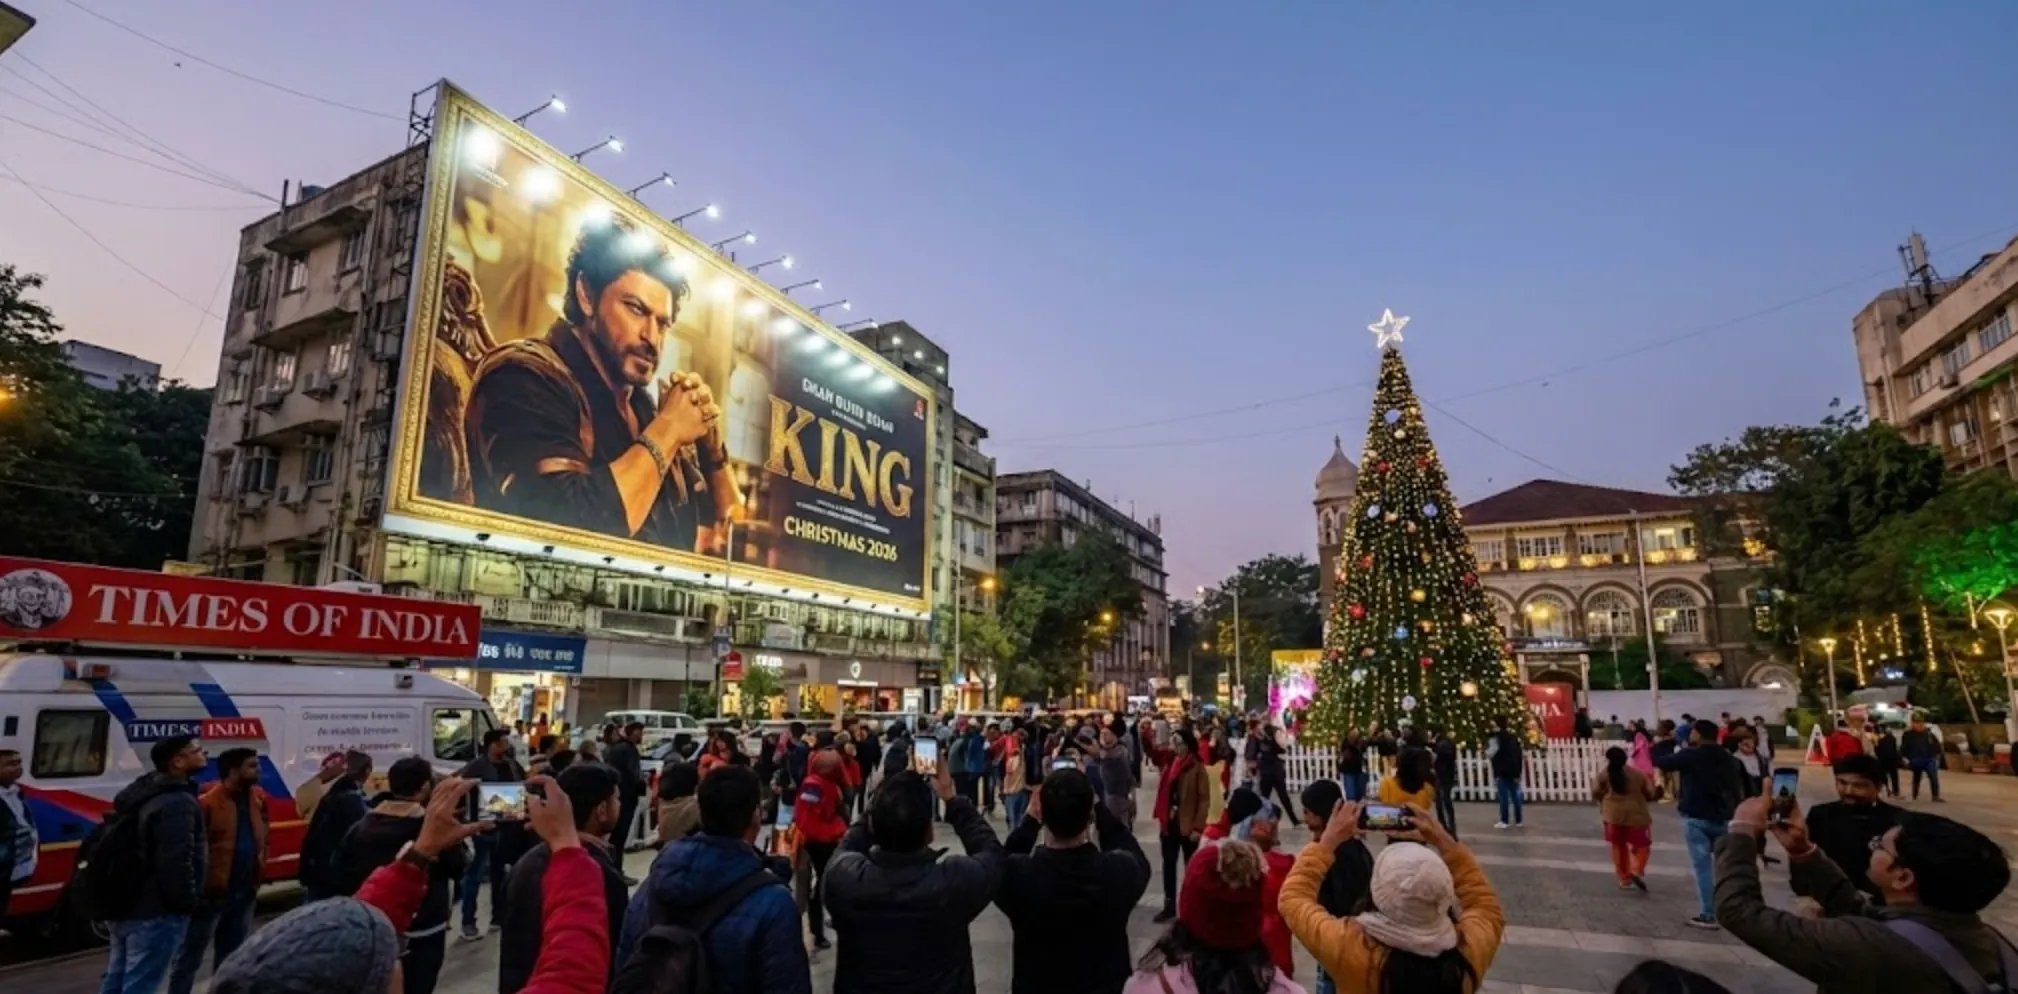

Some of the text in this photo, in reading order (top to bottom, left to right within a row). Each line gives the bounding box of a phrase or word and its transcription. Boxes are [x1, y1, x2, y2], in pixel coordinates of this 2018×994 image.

[764, 393, 914, 518] KING
[784, 515, 865, 553] CHRISTMAS
[88, 584, 469, 645] TIMES OF INDIA
[129, 722, 190, 738] TIMES
[208, 722, 258, 736] INDIA
